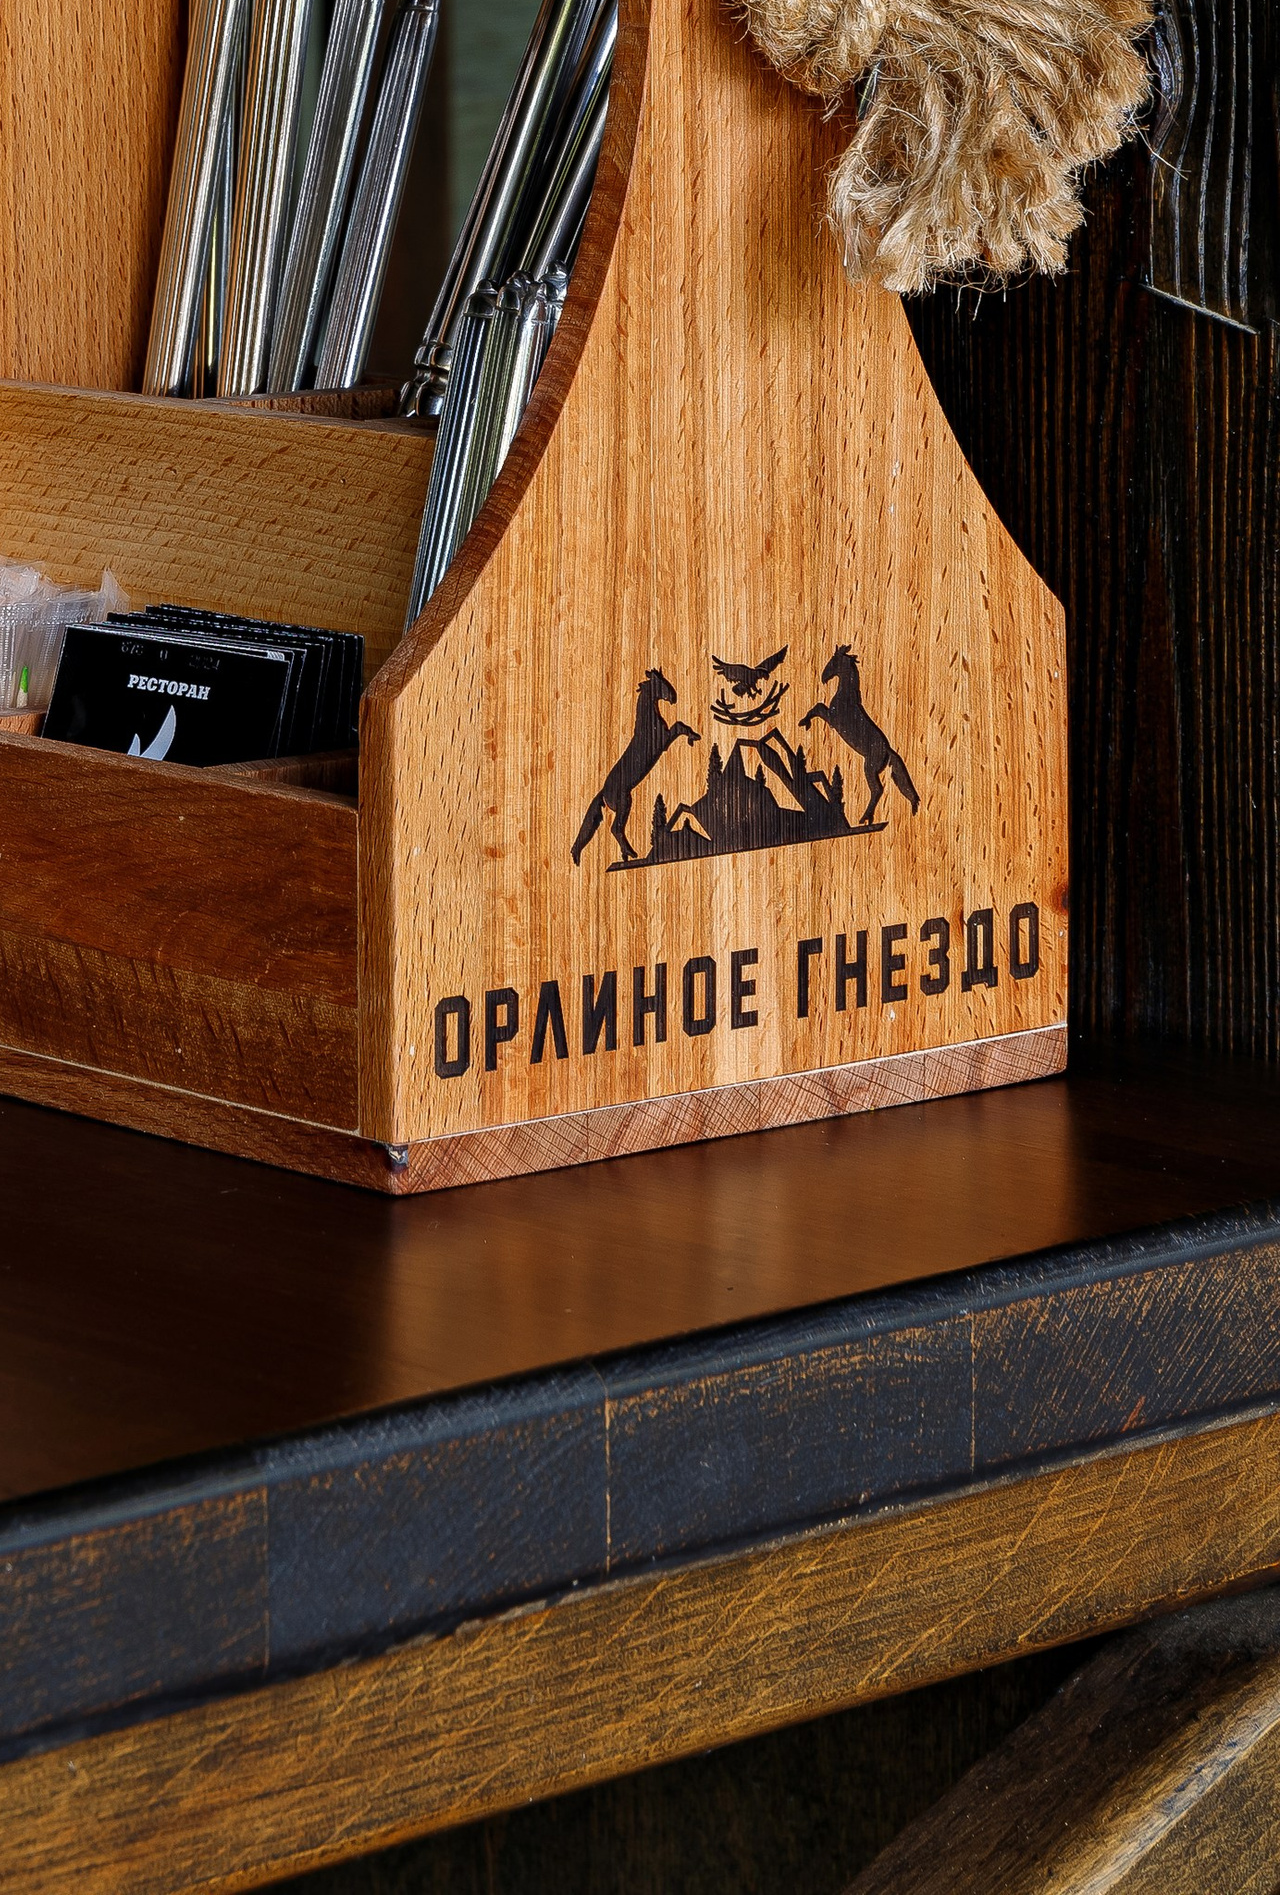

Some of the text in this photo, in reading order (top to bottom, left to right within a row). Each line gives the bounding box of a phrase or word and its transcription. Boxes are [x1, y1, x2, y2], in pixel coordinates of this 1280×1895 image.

[126, 673, 211, 701] РЕСТОРАН
[434, 901, 1039, 1079] ОРЛИНОЕ ГНЕЗДО
